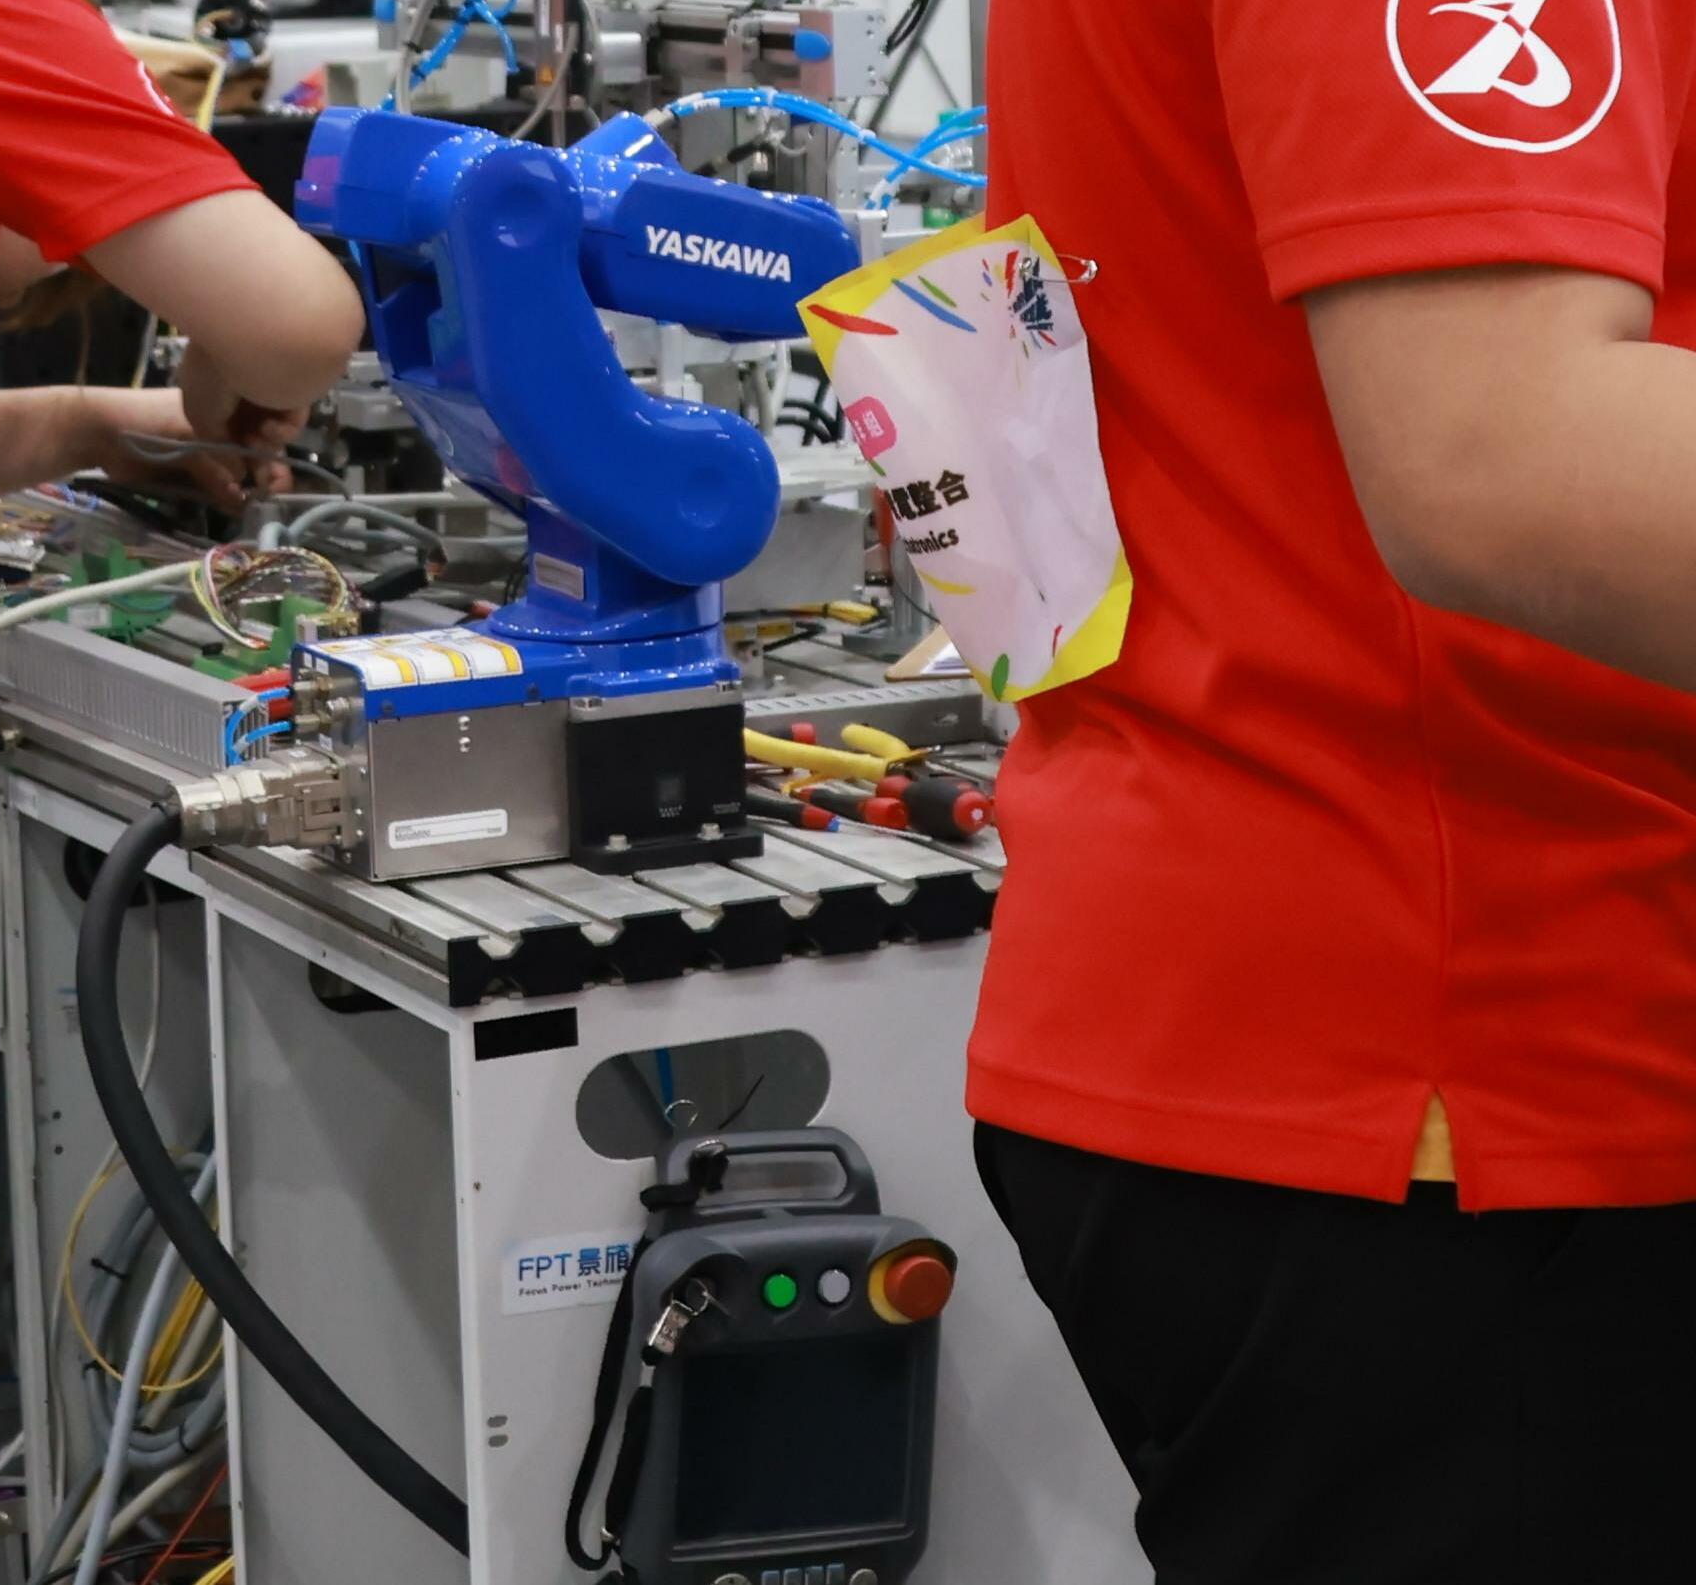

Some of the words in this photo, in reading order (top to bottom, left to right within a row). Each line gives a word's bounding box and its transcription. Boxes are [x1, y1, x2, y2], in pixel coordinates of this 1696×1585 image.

[645, 224, 792, 283] YASKAWA
[518, 1252, 573, 1282] FPT
[551, 1282, 582, 1292] Power
